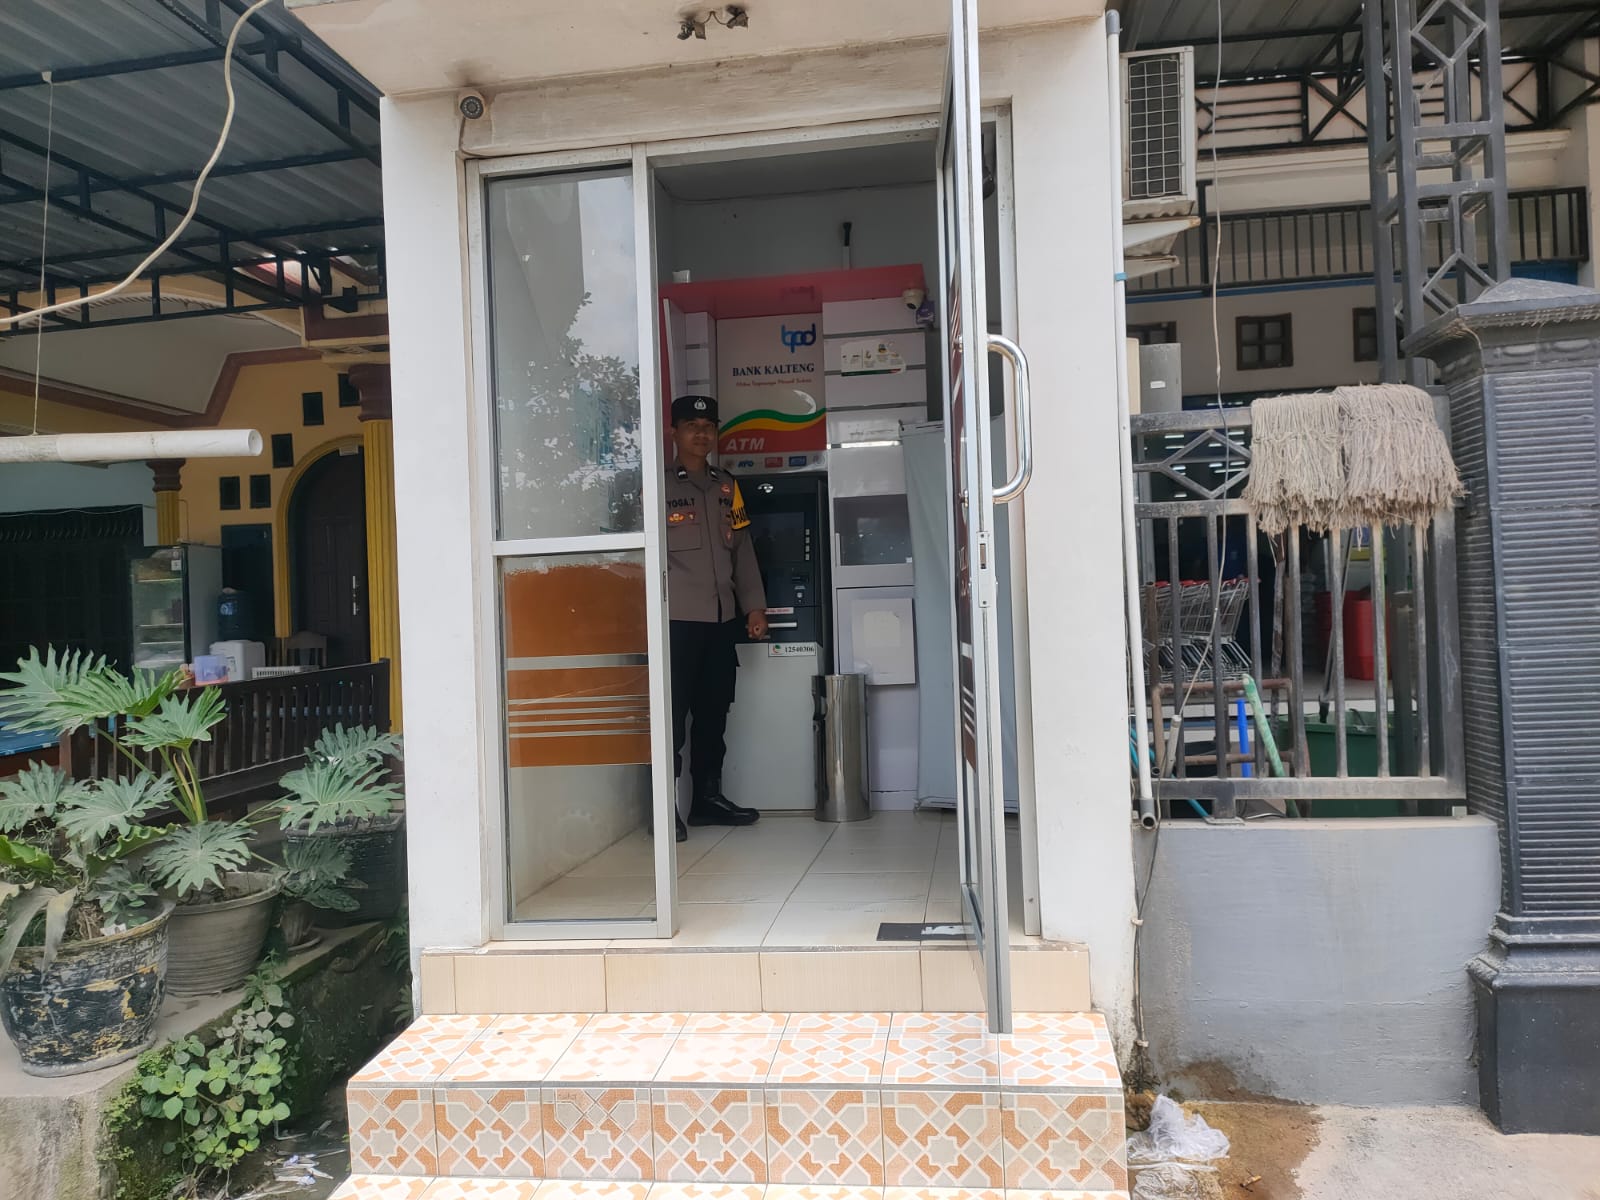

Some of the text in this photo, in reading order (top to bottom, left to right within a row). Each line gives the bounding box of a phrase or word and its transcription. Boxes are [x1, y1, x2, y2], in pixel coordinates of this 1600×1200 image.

[781, 323, 817, 353] bpd
[732, 363, 815, 377] BANK KALTENG
[725, 437, 765, 452] ATM
